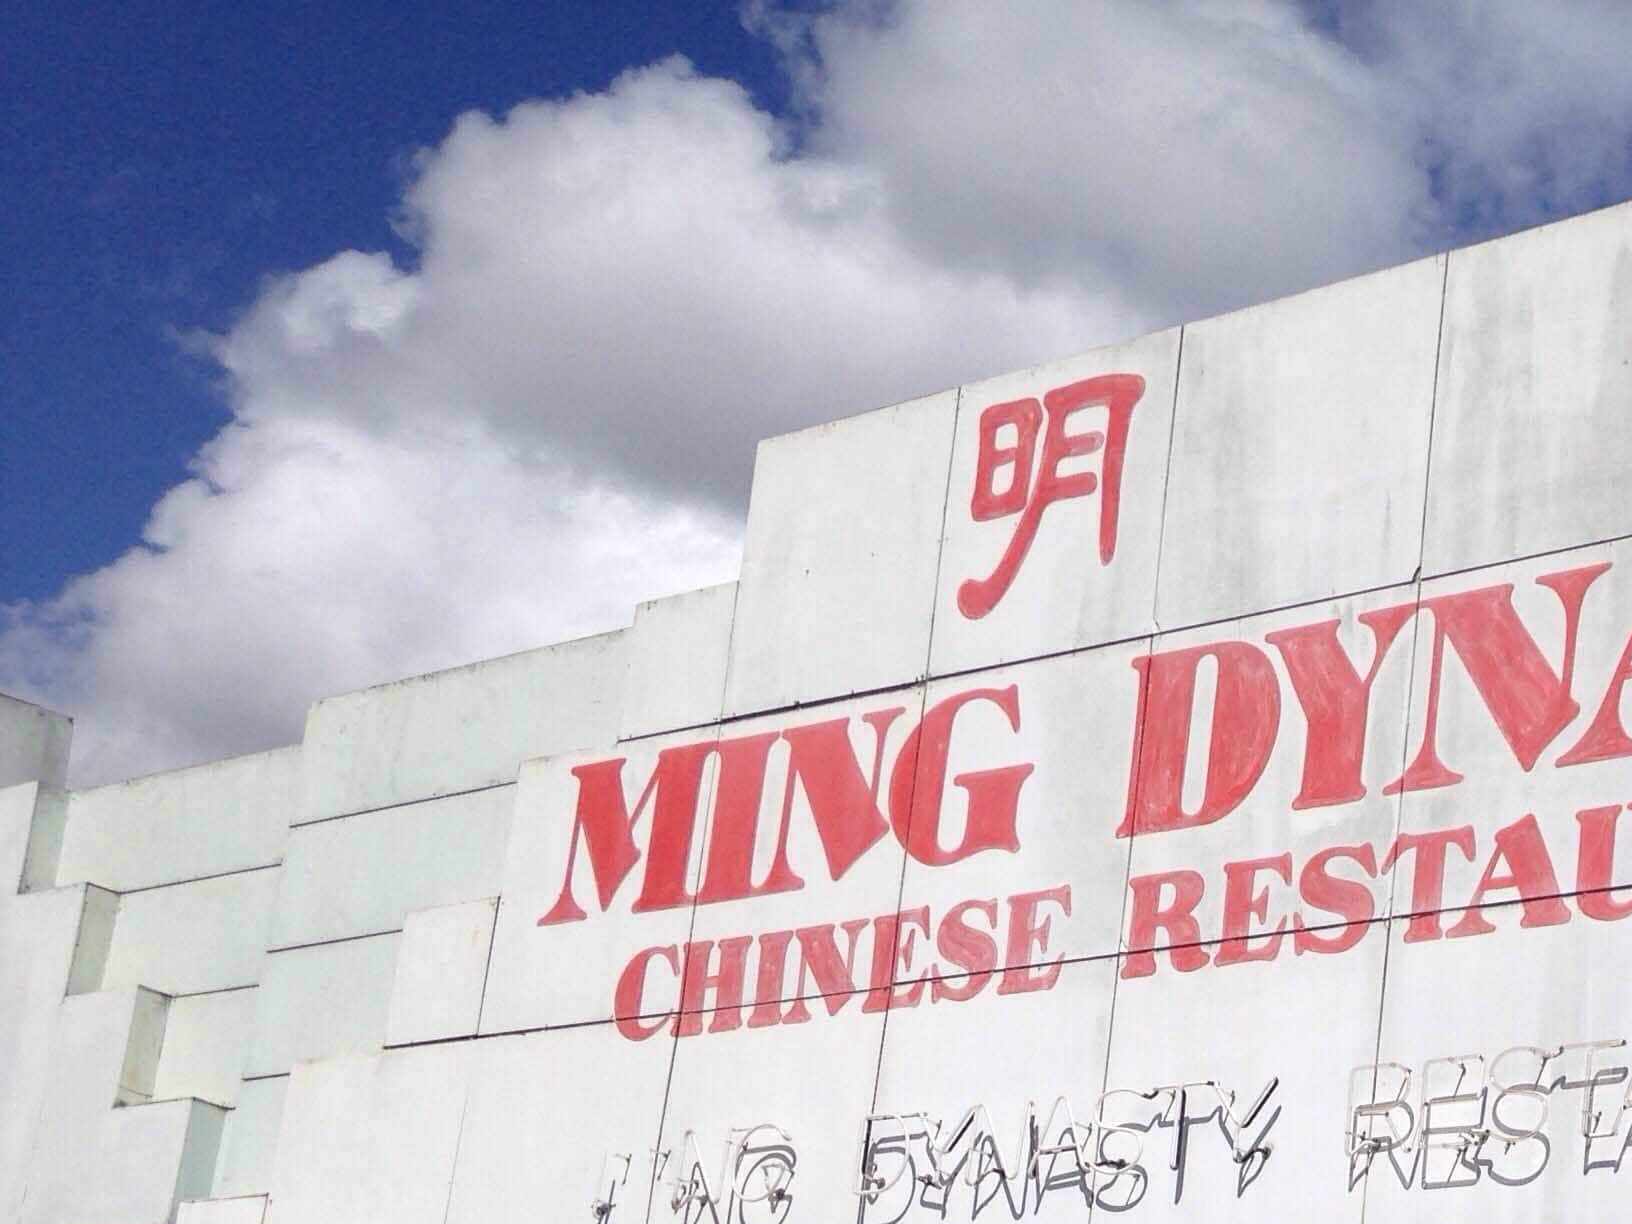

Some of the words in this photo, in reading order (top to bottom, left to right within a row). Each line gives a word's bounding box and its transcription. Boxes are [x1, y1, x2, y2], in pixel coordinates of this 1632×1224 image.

[957, 373, 1146, 619] 明
[538, 684, 1034, 926] MING
[615, 884, 1073, 1042] CHINESE
